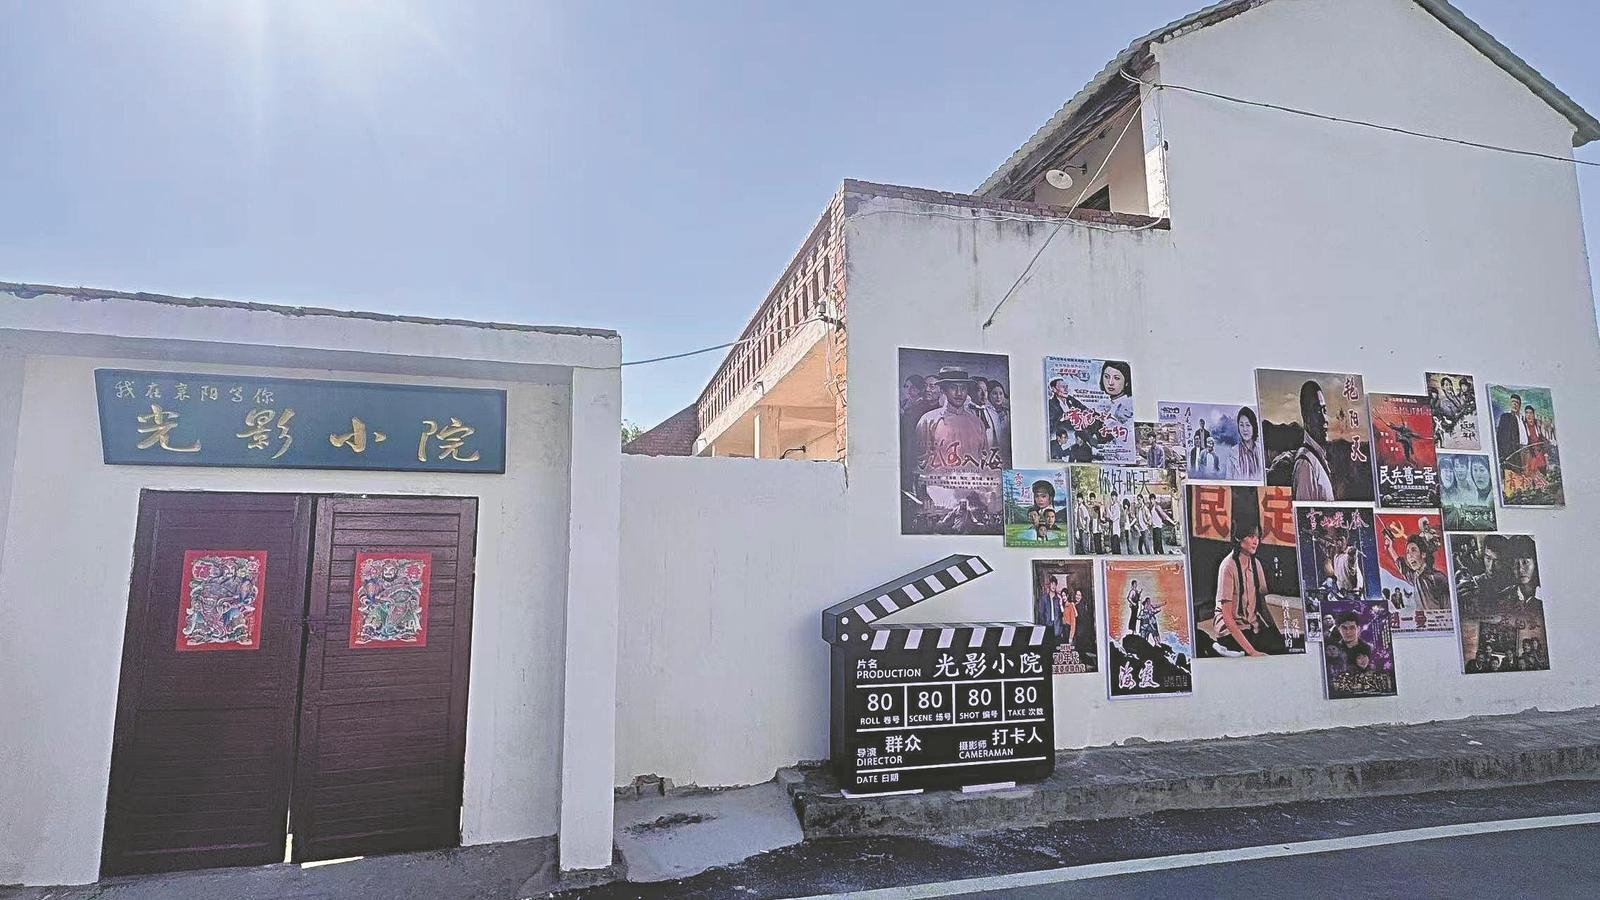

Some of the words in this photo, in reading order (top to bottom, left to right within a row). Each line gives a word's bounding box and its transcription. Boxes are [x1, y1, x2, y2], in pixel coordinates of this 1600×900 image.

[136, 403, 480, 463] 光影小院
[857, 659, 877, 669] 片名
[933, 652, 1043, 678] 光影小院
[857, 668, 921, 679] PRODUCTION
[918, 691, 943, 709] 80
[968, 688, 992, 706] 80
[1014, 686, 1038, 704] 80
[867, 693, 893, 711] 80
[959, 712, 980, 720] SHOT
[982, 710, 998, 719] 编号
[1008, 708, 1026, 717] TAKE
[1028, 707, 1044, 716] 次数
[860, 717, 880, 725] ROLL
[884, 715, 900, 725] 卷号
[909, 714, 933, 722] SCENE
[992, 726, 1043, 746] 打卡人
[885, 734, 922, 753] 群众
[959, 740, 987, 750] 摄影师
[857, 748, 876, 758] 导演
[959, 748, 1014, 759] CAMERAMAN
[857, 755, 903, 767] DIRECTOR
[857, 775, 878, 784] DATE
[881, 773, 899, 783] 日期
